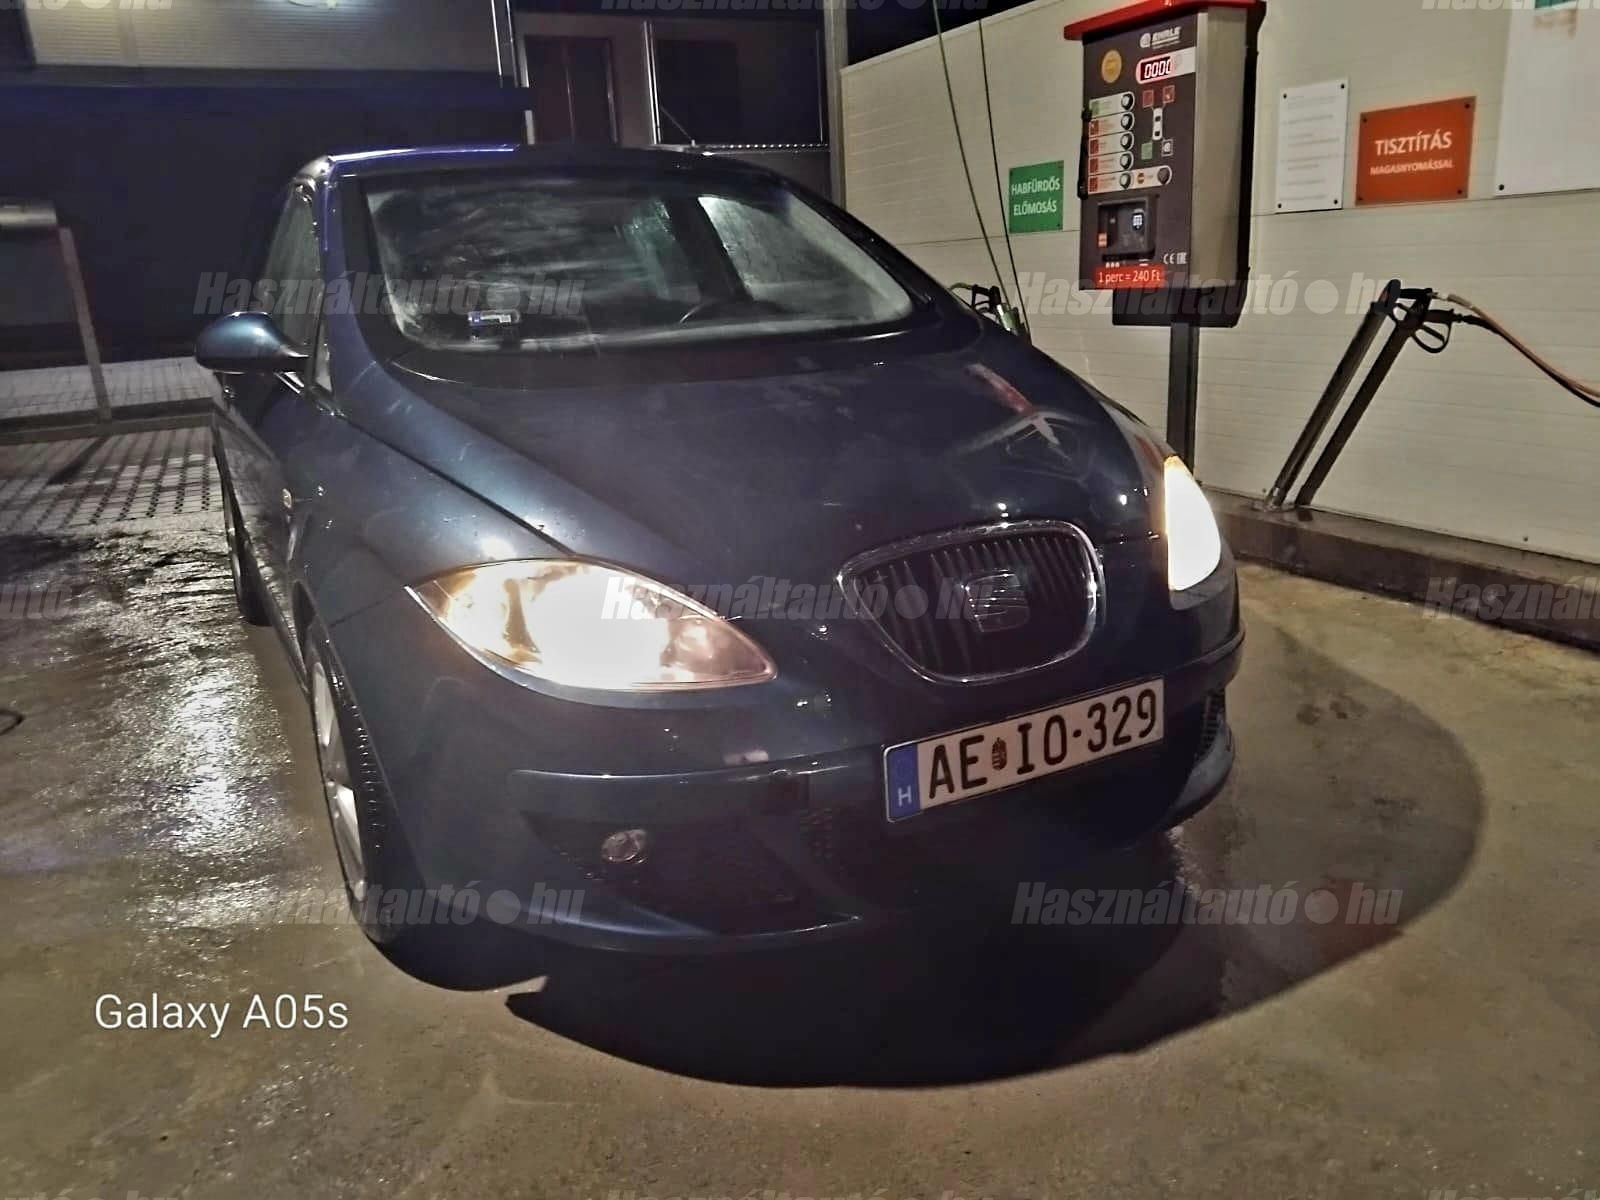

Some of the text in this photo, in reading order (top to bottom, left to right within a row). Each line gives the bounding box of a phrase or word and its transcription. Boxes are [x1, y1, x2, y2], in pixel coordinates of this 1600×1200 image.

[1374, 128, 1453, 157] TISZTÍTÁS
[1099, 272, 1104, 283] 1
[1105, 272, 1124, 286] perc
[1132, 270, 1149, 282] 240
[1151, 269, 1161, 281] Ft
[928, 734, 988, 799] AE
[897, 786, 913, 807] H
